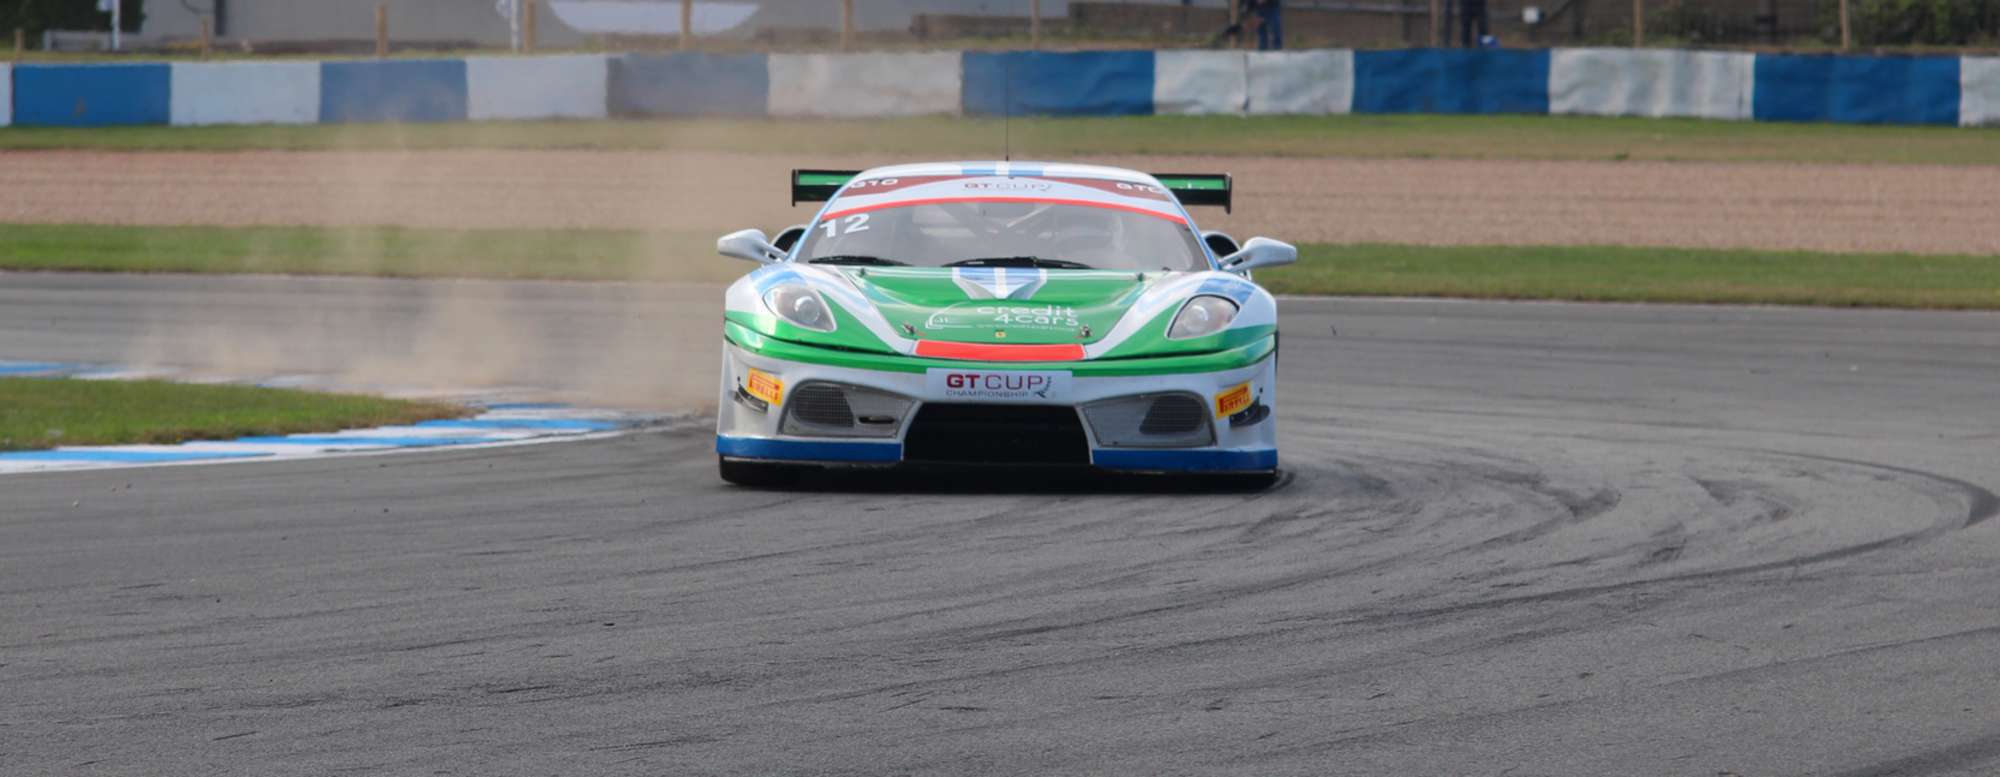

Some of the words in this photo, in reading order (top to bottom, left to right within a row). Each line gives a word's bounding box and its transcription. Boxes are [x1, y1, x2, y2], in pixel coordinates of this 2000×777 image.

[820, 213, 870, 237] 12
[976, 305, 1079, 318] credit
[993, 314, 1079, 326] 4cars
[946, 373, 980, 389] GT
[985, 374, 1043, 390] CUP
[945, 389, 1028, 398] CHAMPIONSHIP
[1219, 386, 1250, 414] PIRELLI
